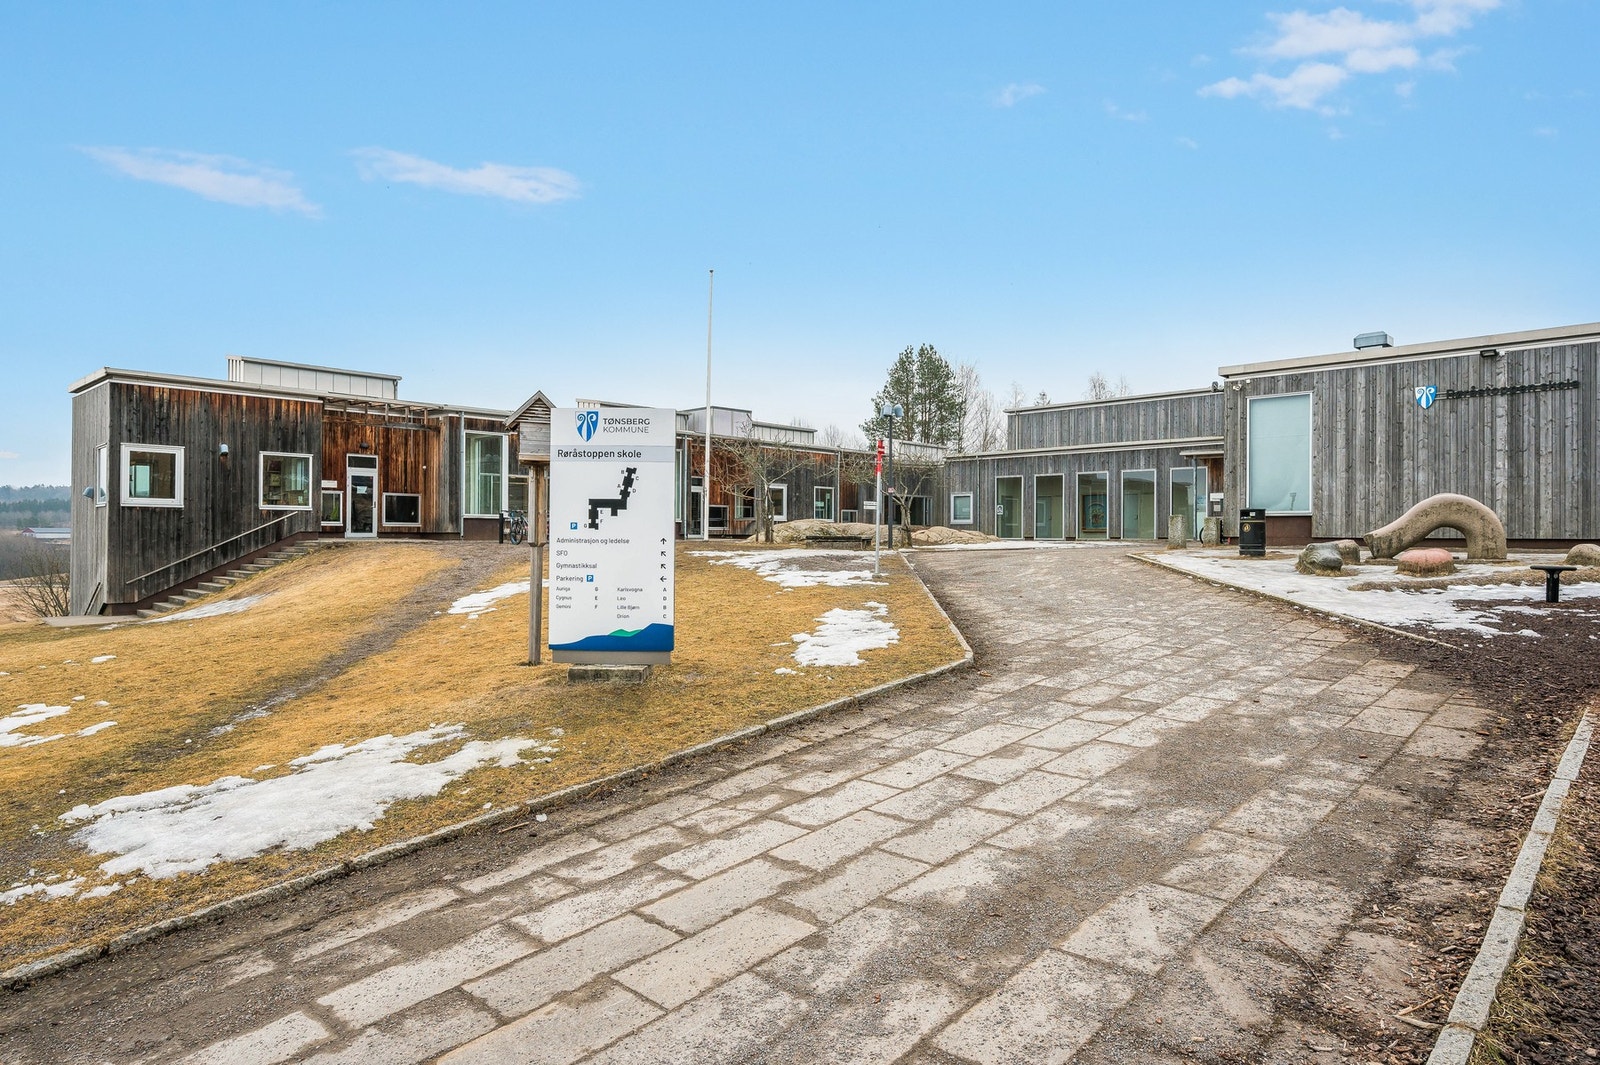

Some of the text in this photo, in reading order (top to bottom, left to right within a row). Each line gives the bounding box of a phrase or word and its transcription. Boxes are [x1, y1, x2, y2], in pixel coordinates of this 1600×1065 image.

[603, 417, 650, 426] TØNSBERG
[557, 448, 642, 460] Røråstoppen skole
